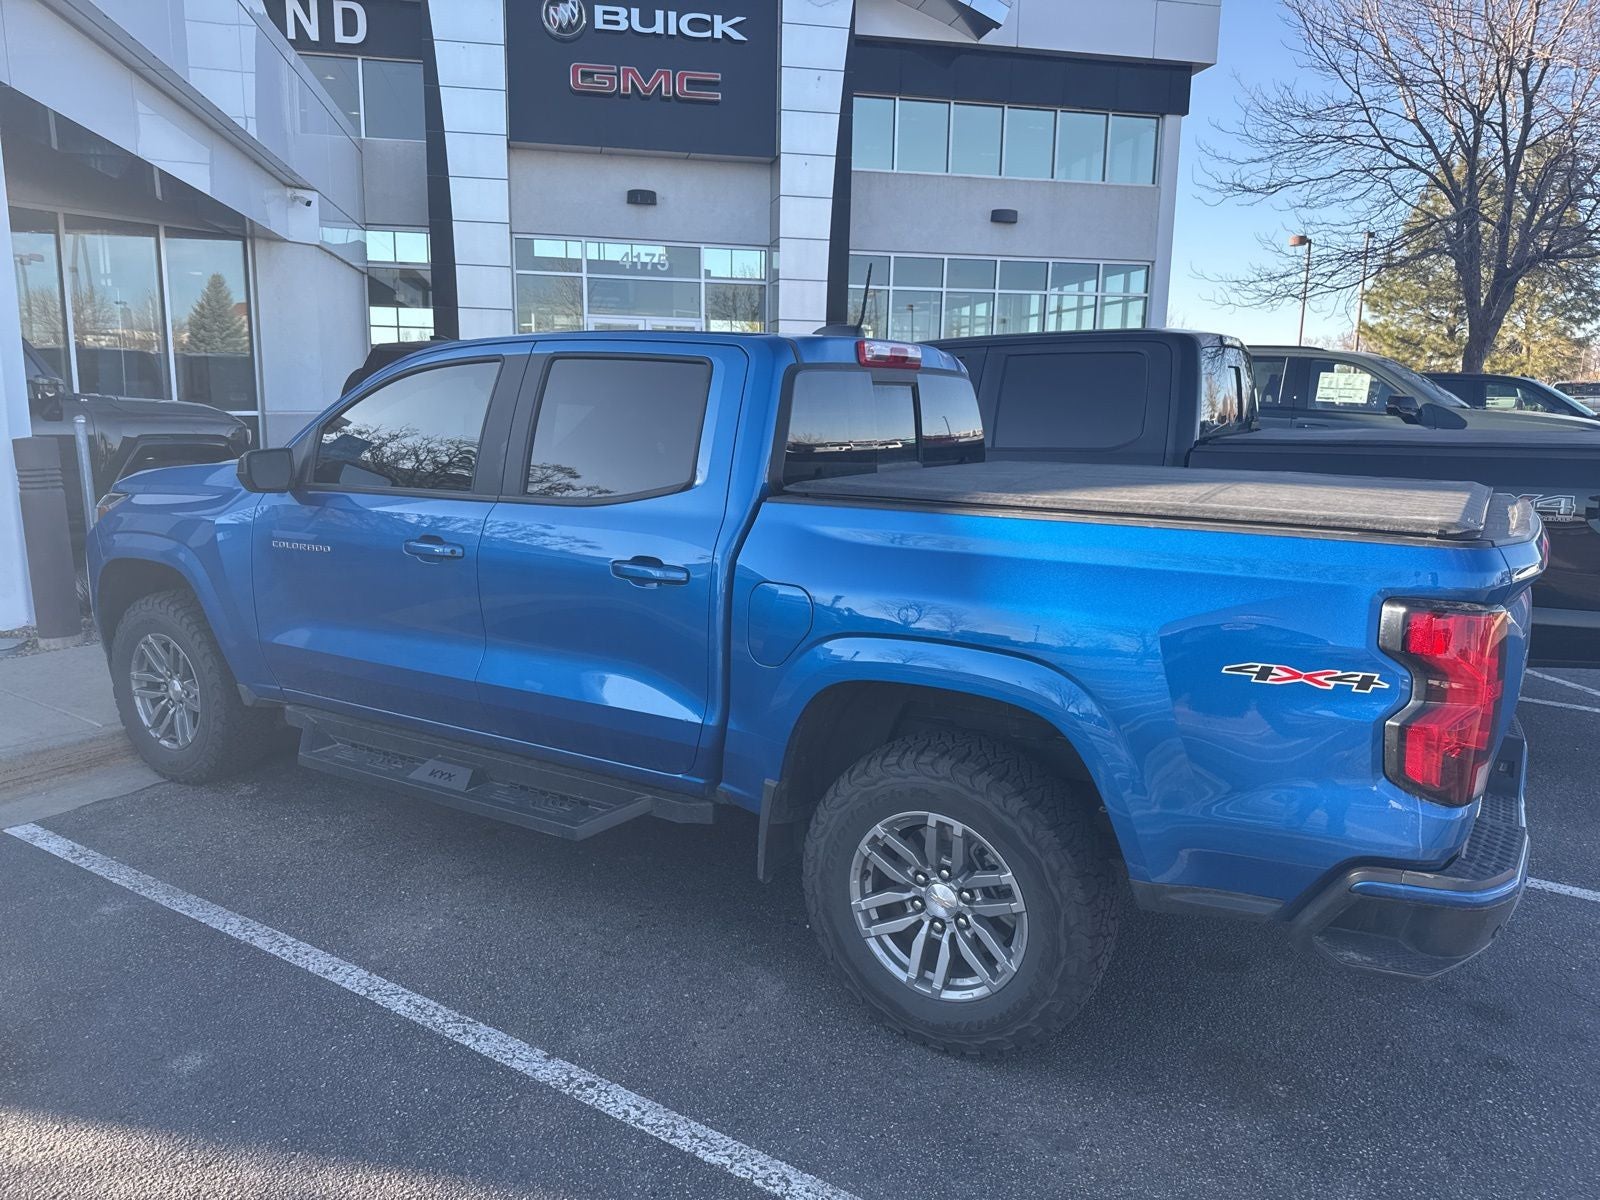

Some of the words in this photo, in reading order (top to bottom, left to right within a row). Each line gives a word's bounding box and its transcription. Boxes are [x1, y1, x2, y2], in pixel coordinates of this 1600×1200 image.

[594, 4, 748, 41] BUICK
[570, 62, 721, 101] GMC
[619, 251, 669, 271] 4175
[272, 540, 331, 552] COLORADO
